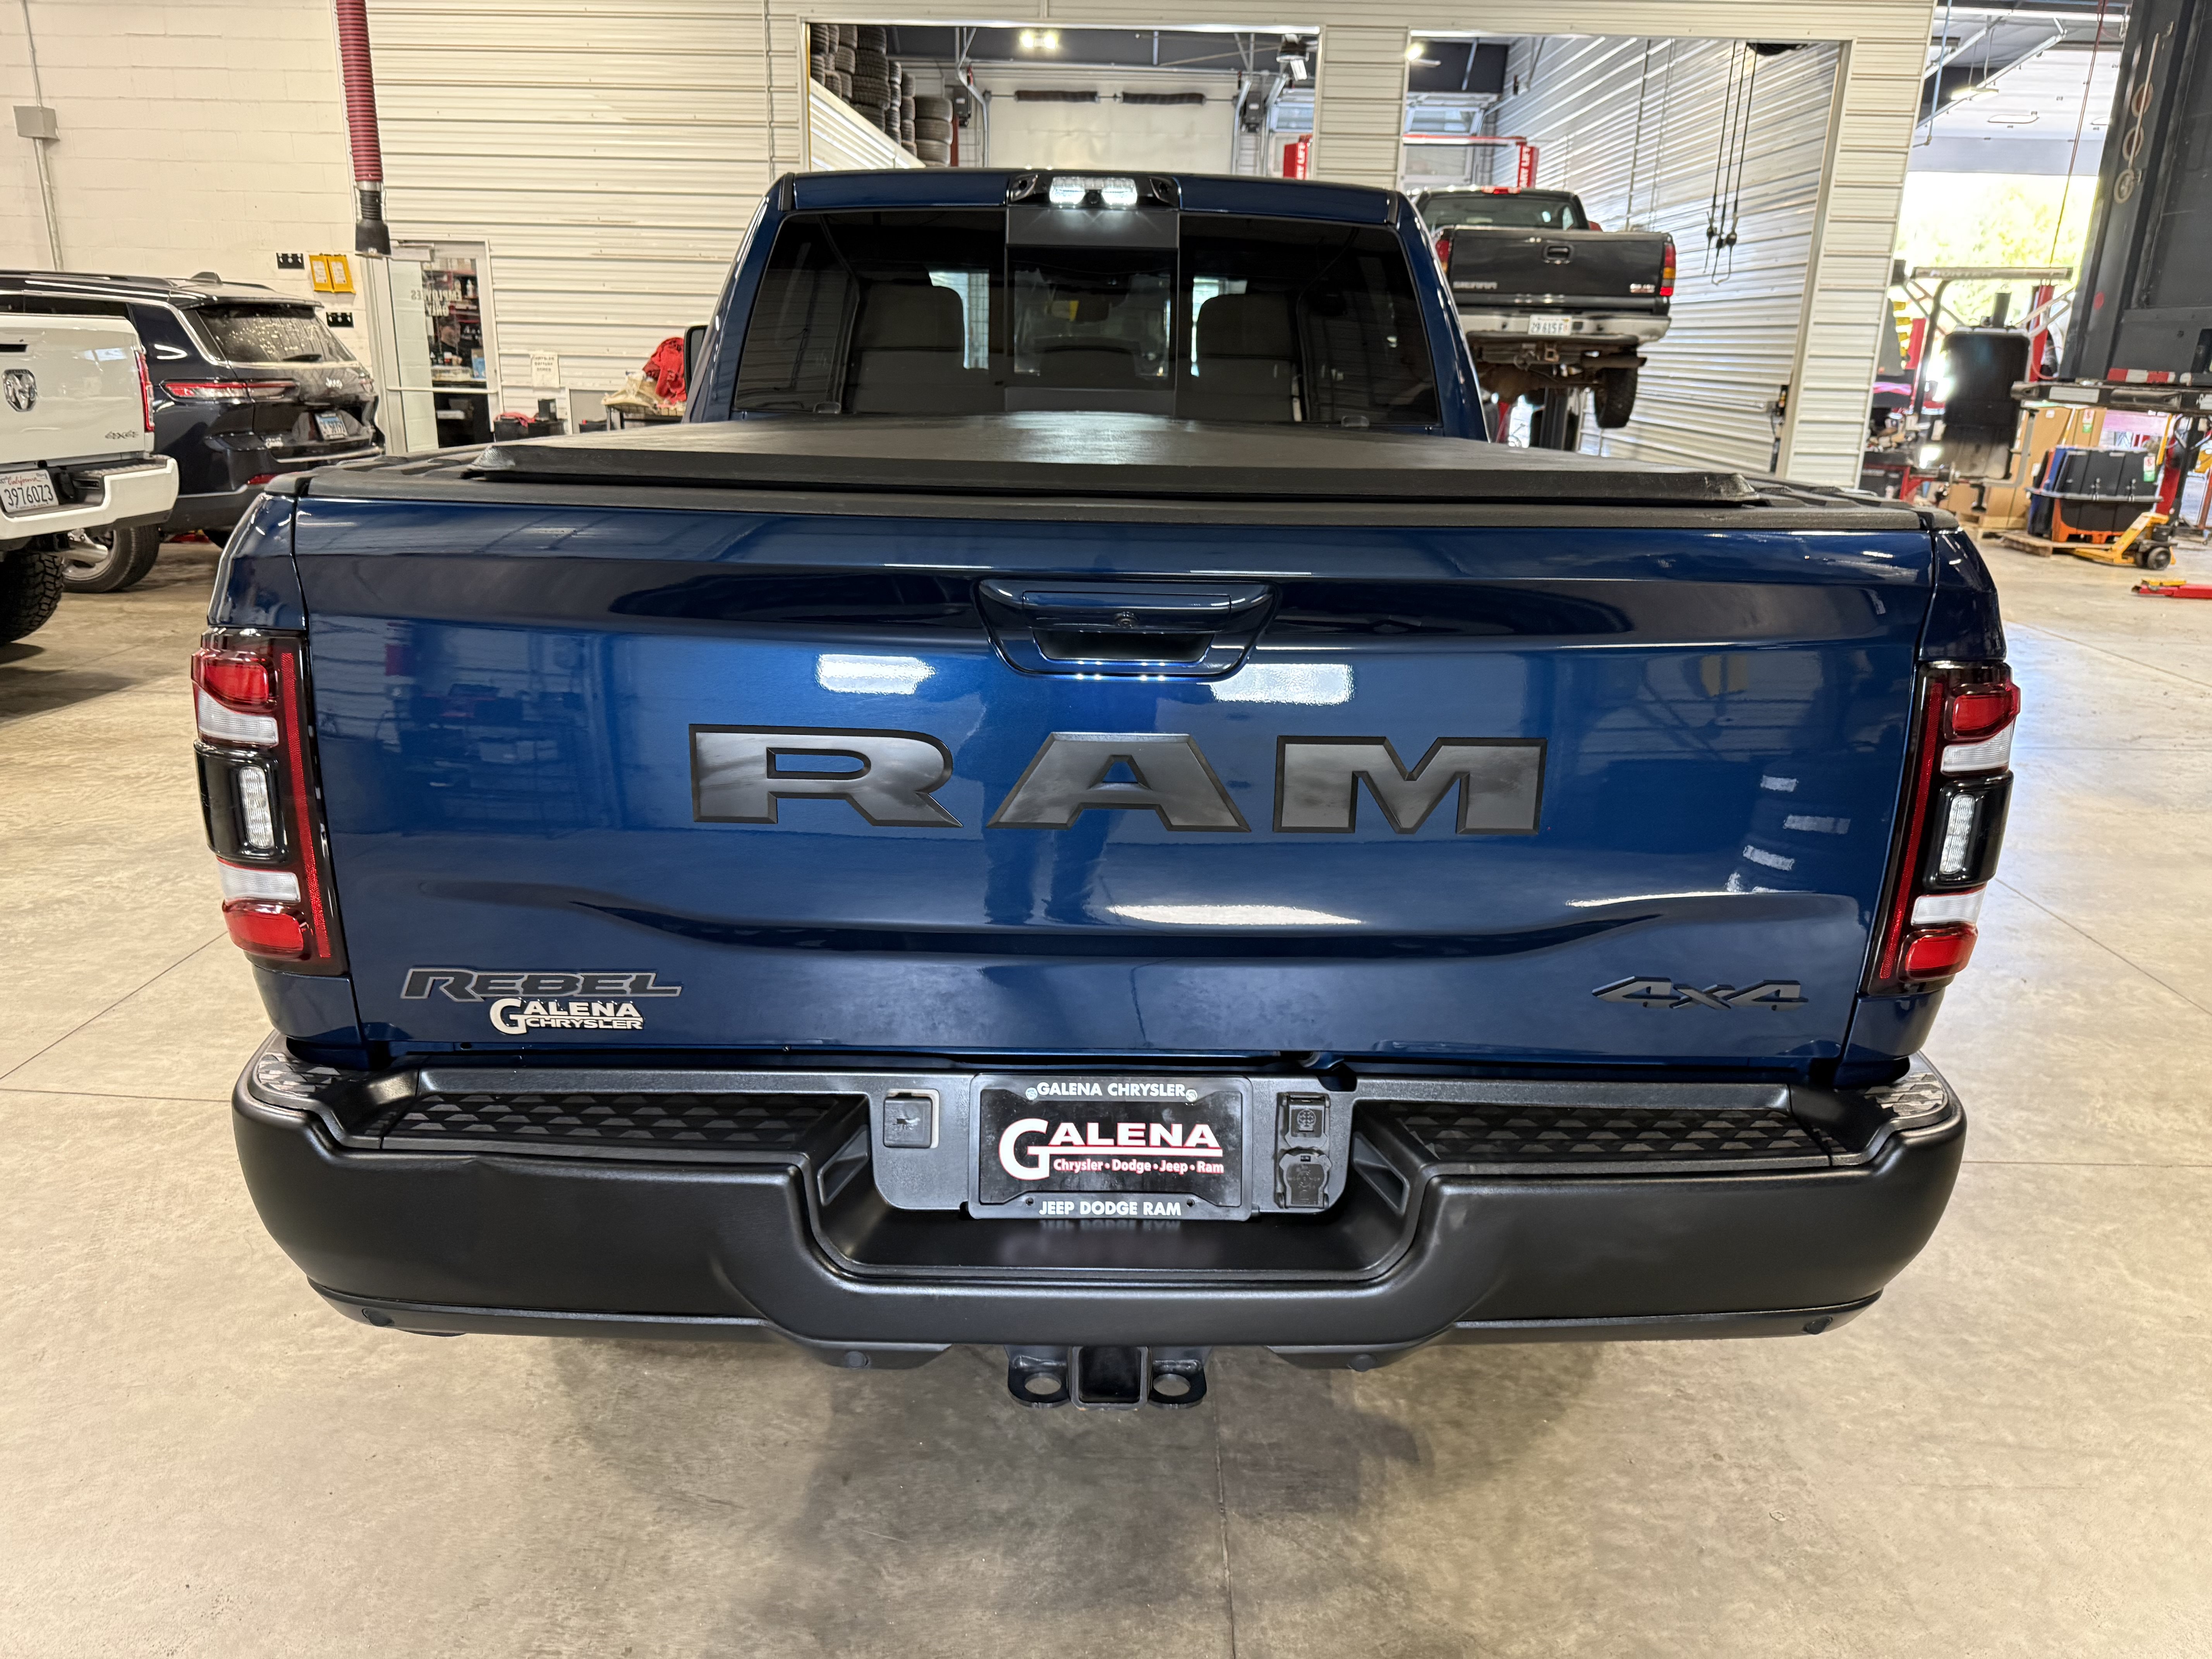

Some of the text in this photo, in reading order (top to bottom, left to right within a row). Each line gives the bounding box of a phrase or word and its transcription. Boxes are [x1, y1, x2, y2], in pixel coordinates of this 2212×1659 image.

[8, 476, 38, 486] California
[4, 484, 54, 506] 39760Z3
[689, 723, 1547, 835] RAM
[400, 968, 682, 1002] REBEL
[489, 998, 643, 1034] GALENA
[526, 1017, 644, 1030] CHRYSLER
[1037, 1082, 1186, 1097] GALENA CHRYSLER
[999, 1118, 1223, 1180] GALENA
[1053, 1158, 1224, 1176] Chrysler Dodge Jeep Ram
[1039, 1200, 1182, 1216] JEEP DODGE RAM
